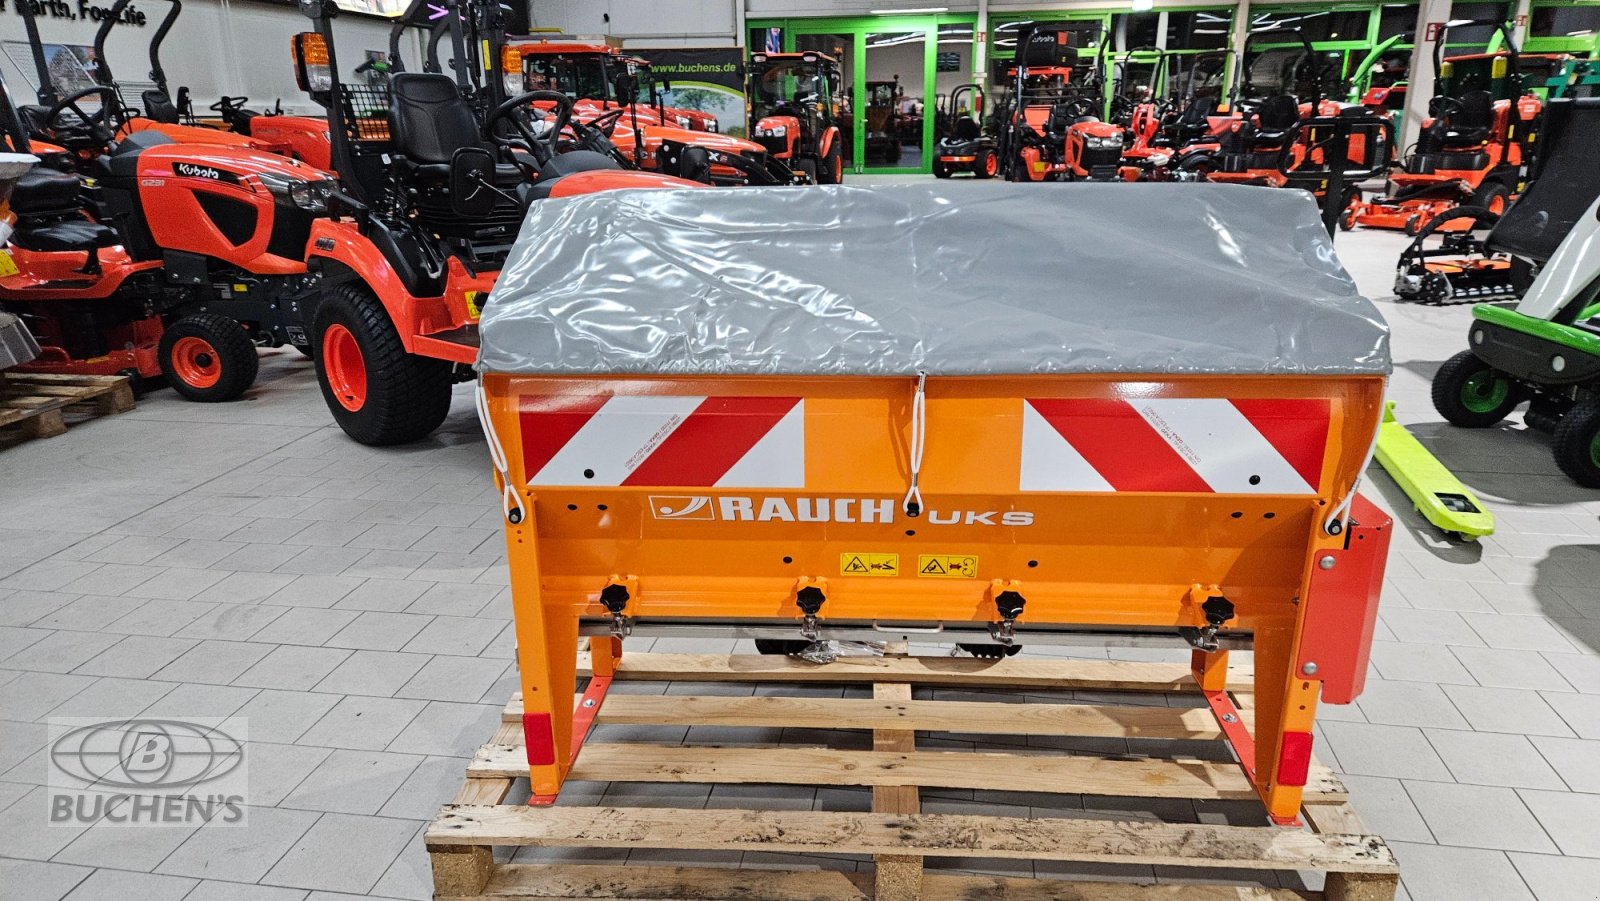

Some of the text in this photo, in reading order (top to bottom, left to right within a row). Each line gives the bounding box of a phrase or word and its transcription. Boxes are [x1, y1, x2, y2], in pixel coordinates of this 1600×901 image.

[651, 62, 736, 73] www.buchens.de
[179, 163, 219, 179] Kubota
[718, 496, 1034, 526] RAUCH UKS
